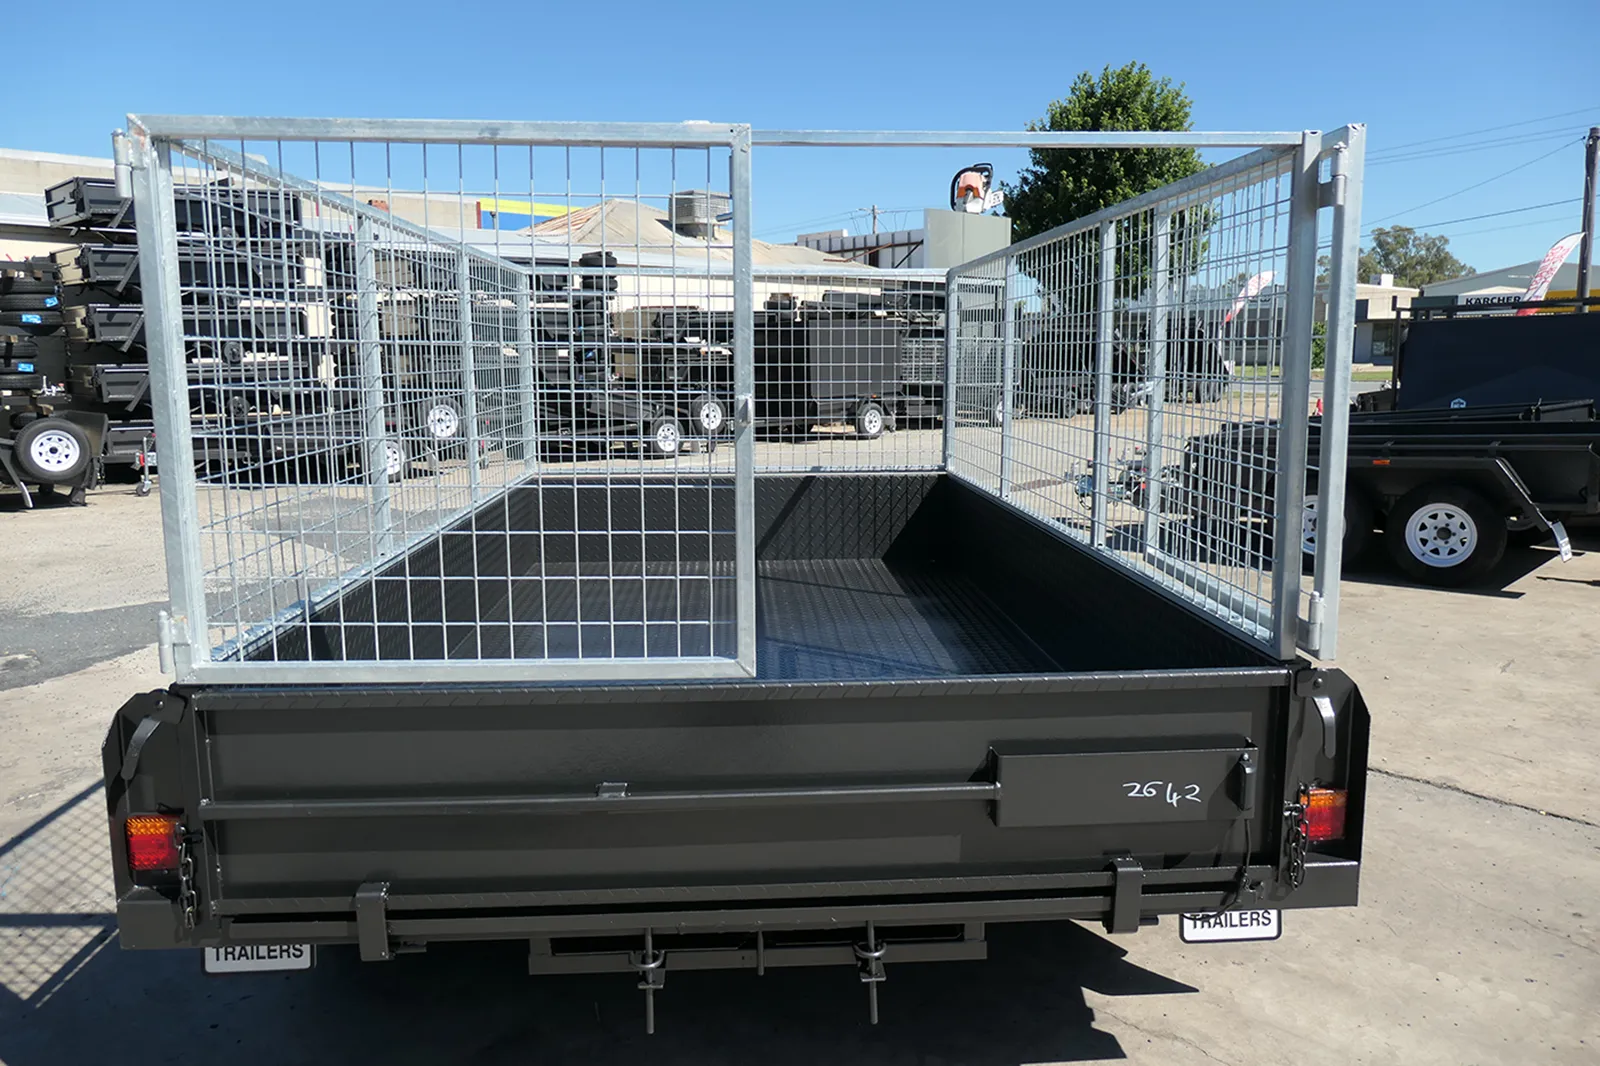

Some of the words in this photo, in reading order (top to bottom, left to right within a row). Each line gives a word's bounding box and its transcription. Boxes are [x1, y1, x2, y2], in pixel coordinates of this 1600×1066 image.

[1122, 781, 1202, 807] 2642
[1190, 910, 1272, 929] TRAILERS
[211, 944, 304, 962] TRAILERS
